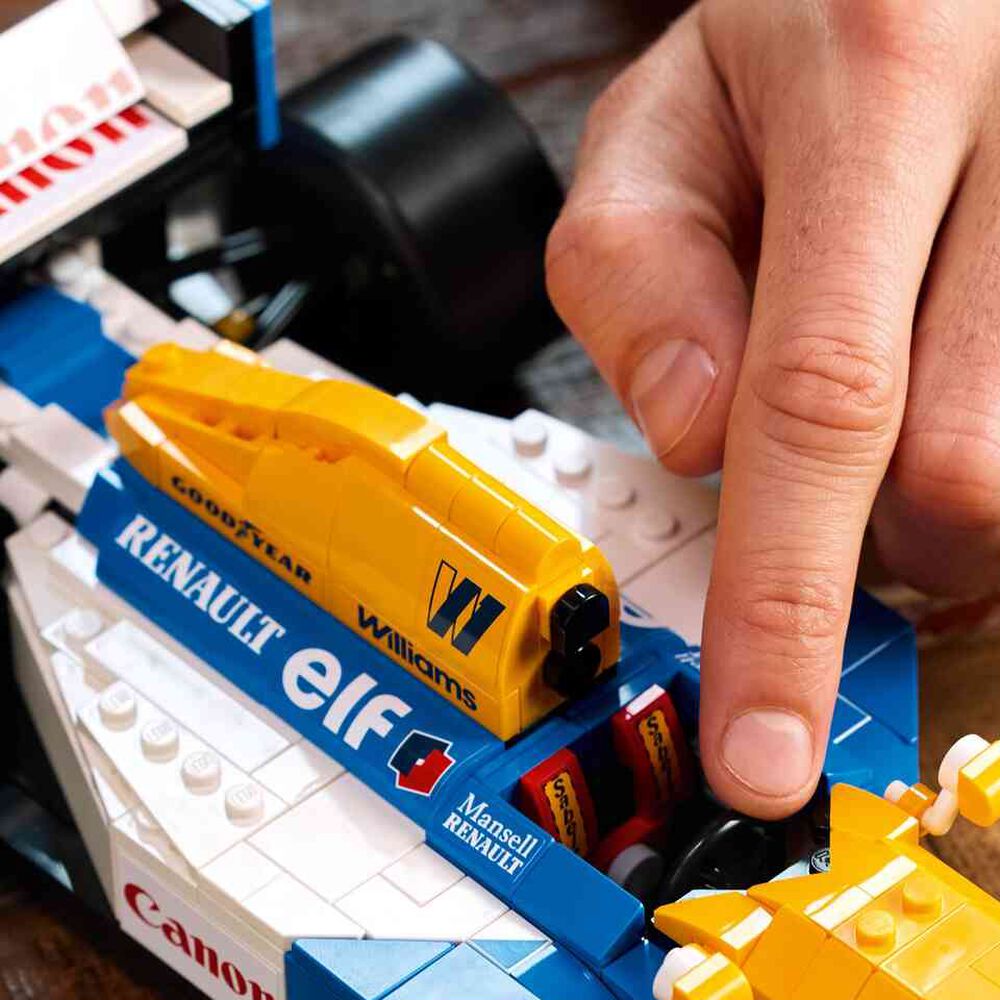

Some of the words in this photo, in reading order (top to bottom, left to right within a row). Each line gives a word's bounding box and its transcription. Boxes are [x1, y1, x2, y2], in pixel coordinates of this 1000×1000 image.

[171, 475, 312, 584] GOODYEAR
[114, 513, 287, 655] RENAULT
[282, 647, 413, 751] elf
[357, 603, 478, 711] Williams
[442, 811, 524, 875] RENAULT
[457, 792, 539, 859] Mansell
